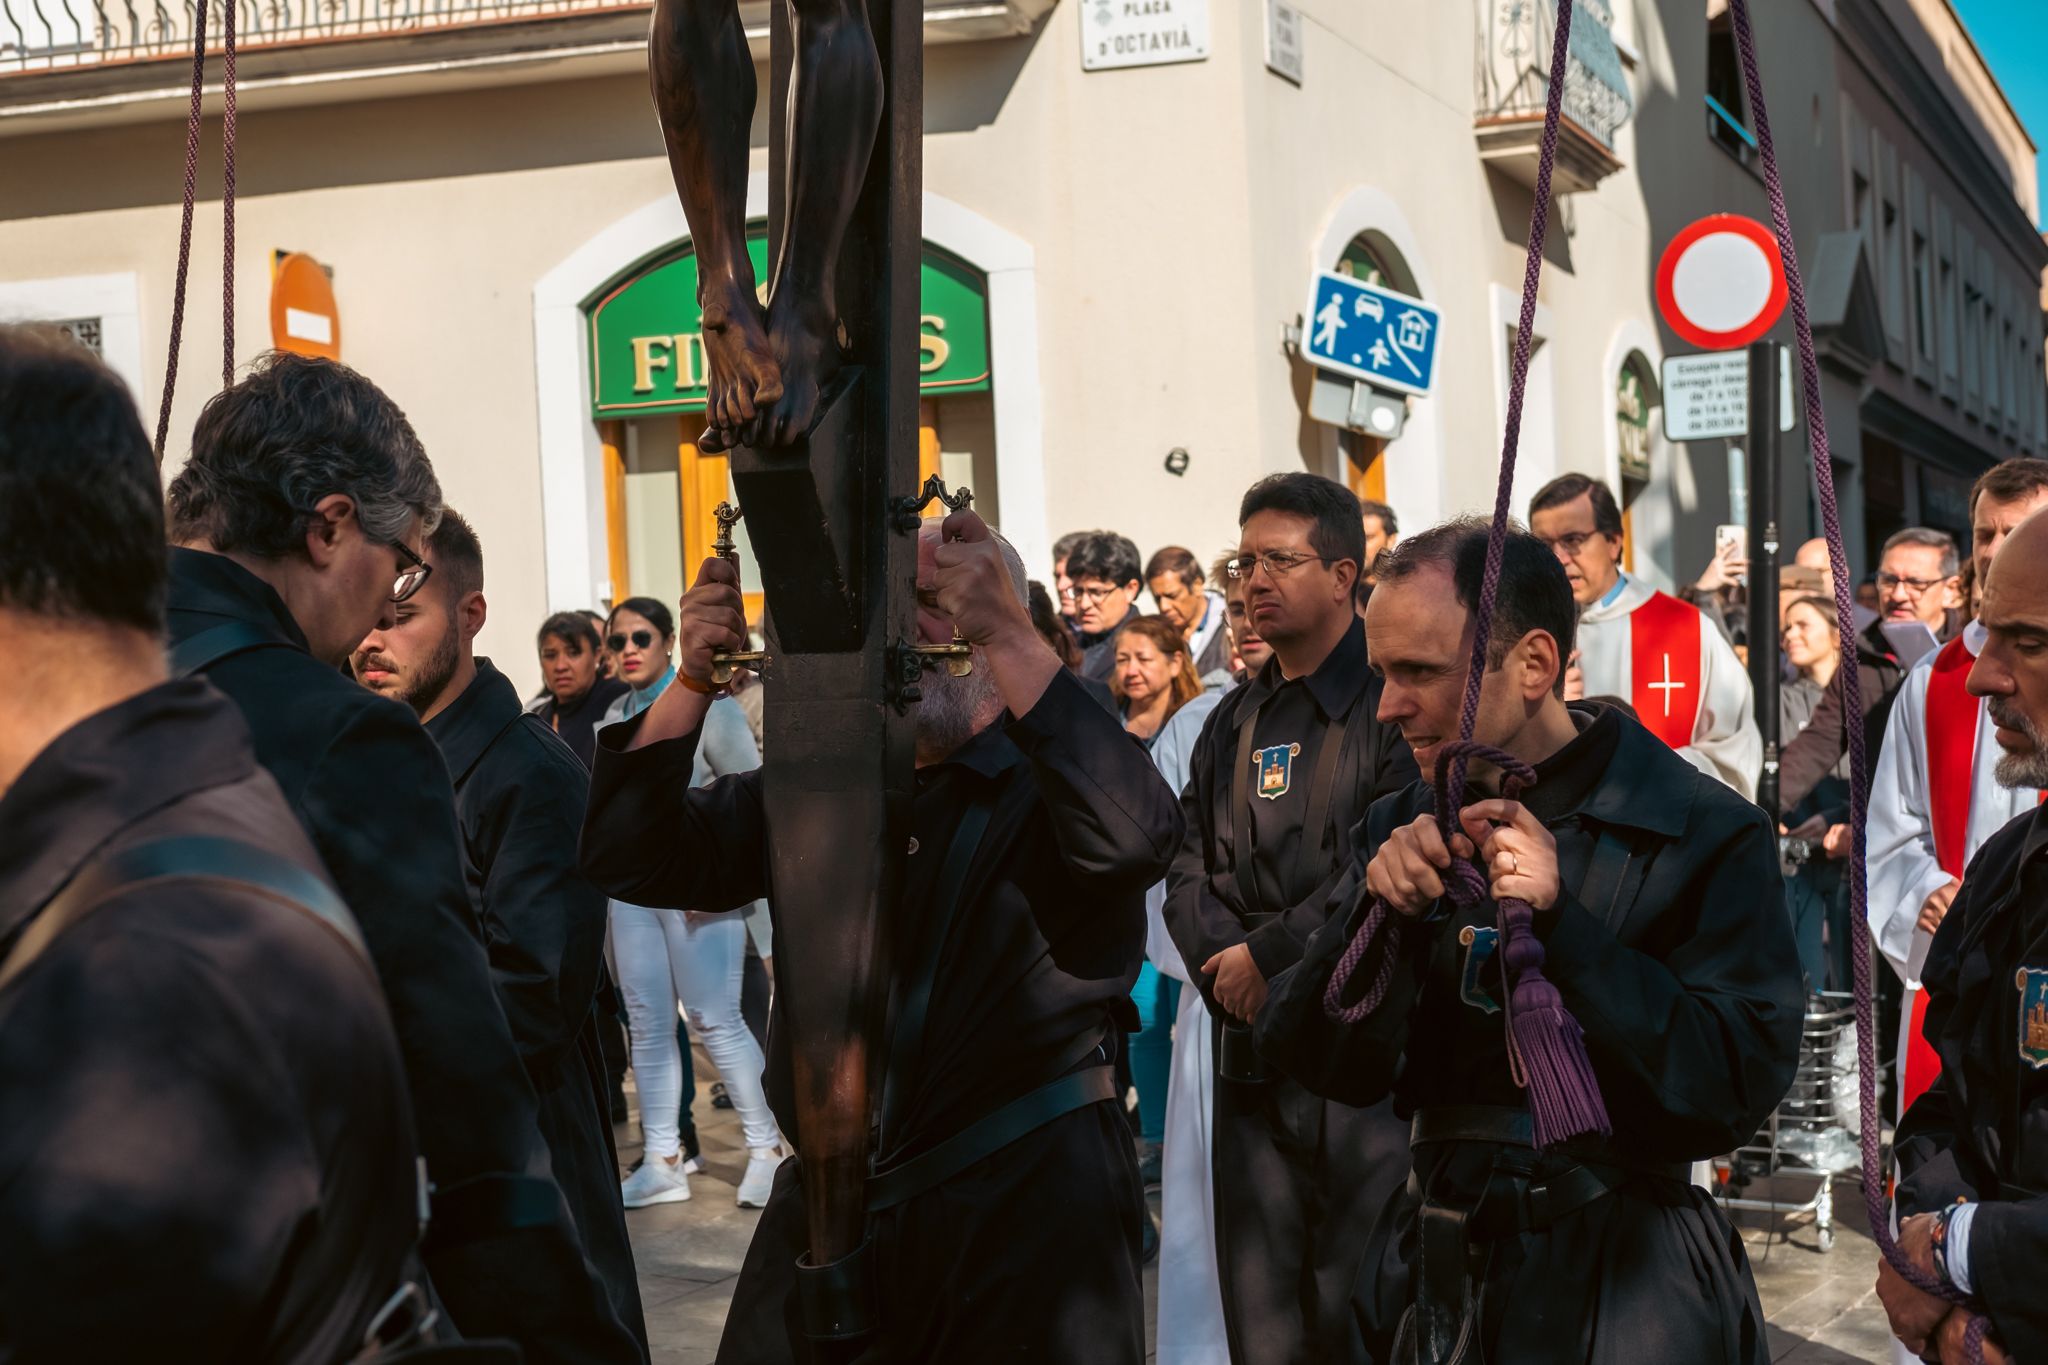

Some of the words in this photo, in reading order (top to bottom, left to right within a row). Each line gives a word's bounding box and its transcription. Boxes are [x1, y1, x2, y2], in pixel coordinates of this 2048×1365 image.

[1689, 390, 1704, 401] de
[1688, 406, 1701, 416] de
[1689, 420, 1702, 431] de
